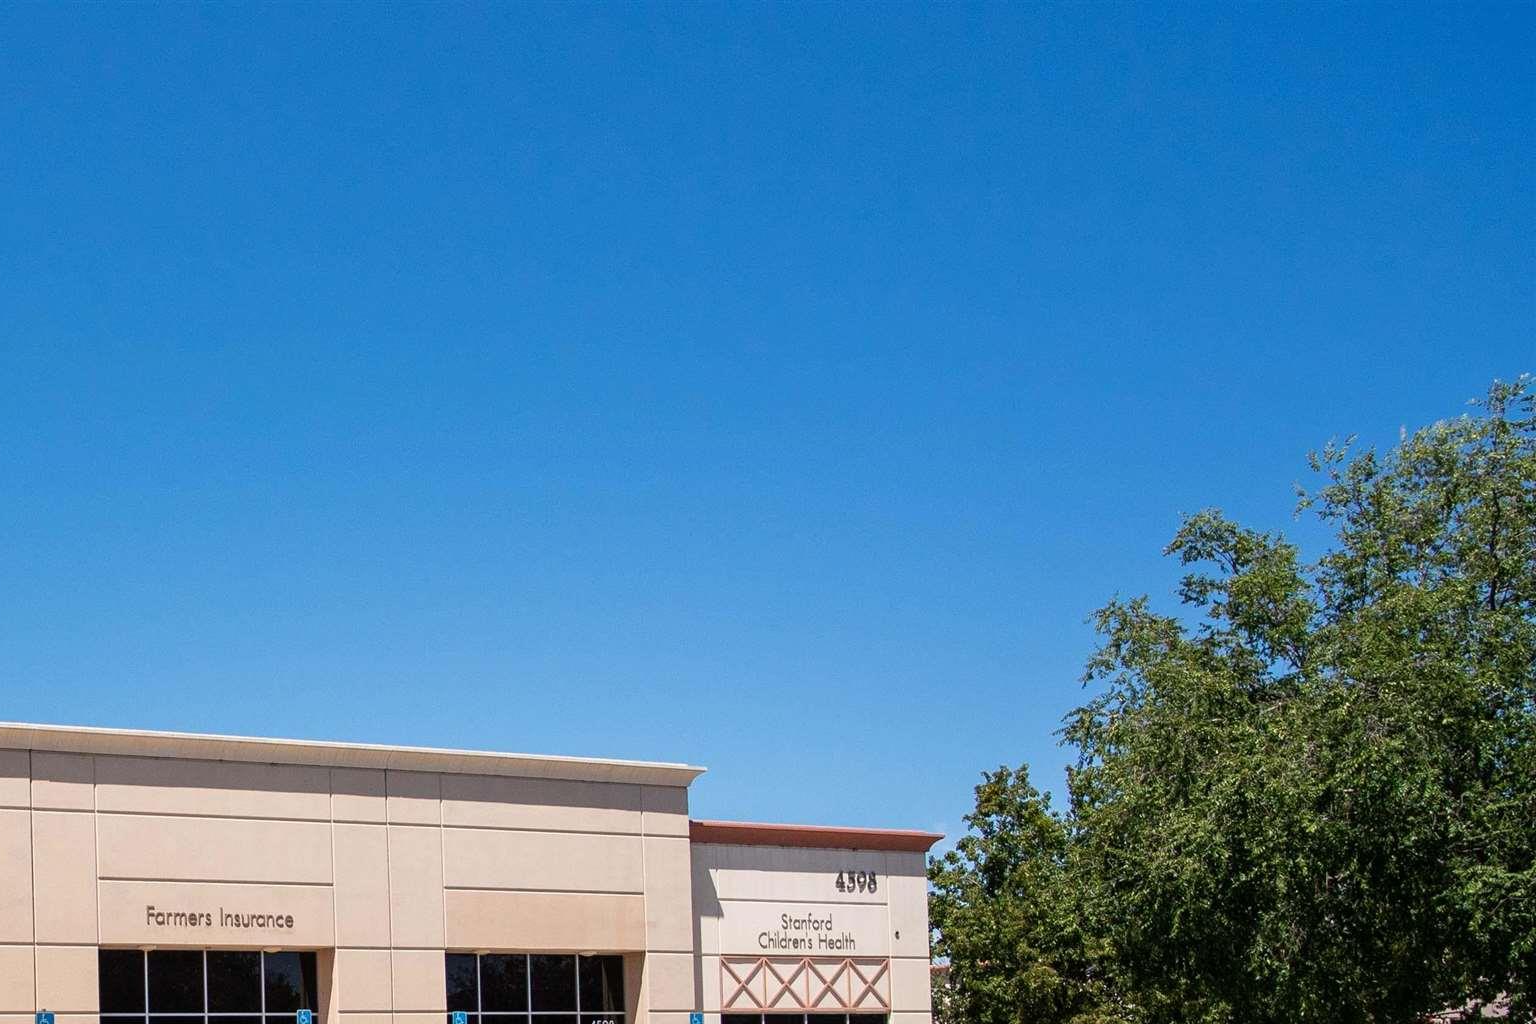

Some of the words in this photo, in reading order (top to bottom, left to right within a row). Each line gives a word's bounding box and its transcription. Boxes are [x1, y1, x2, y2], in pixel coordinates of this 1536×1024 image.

[835, 870, 877, 894] 4598
[146, 905, 212, 927] Farmers
[220, 907, 294, 929] Insurance
[781, 912, 833, 931] Stanford
[758, 932, 813, 950] Children's
[818, 932, 856, 950] Health
